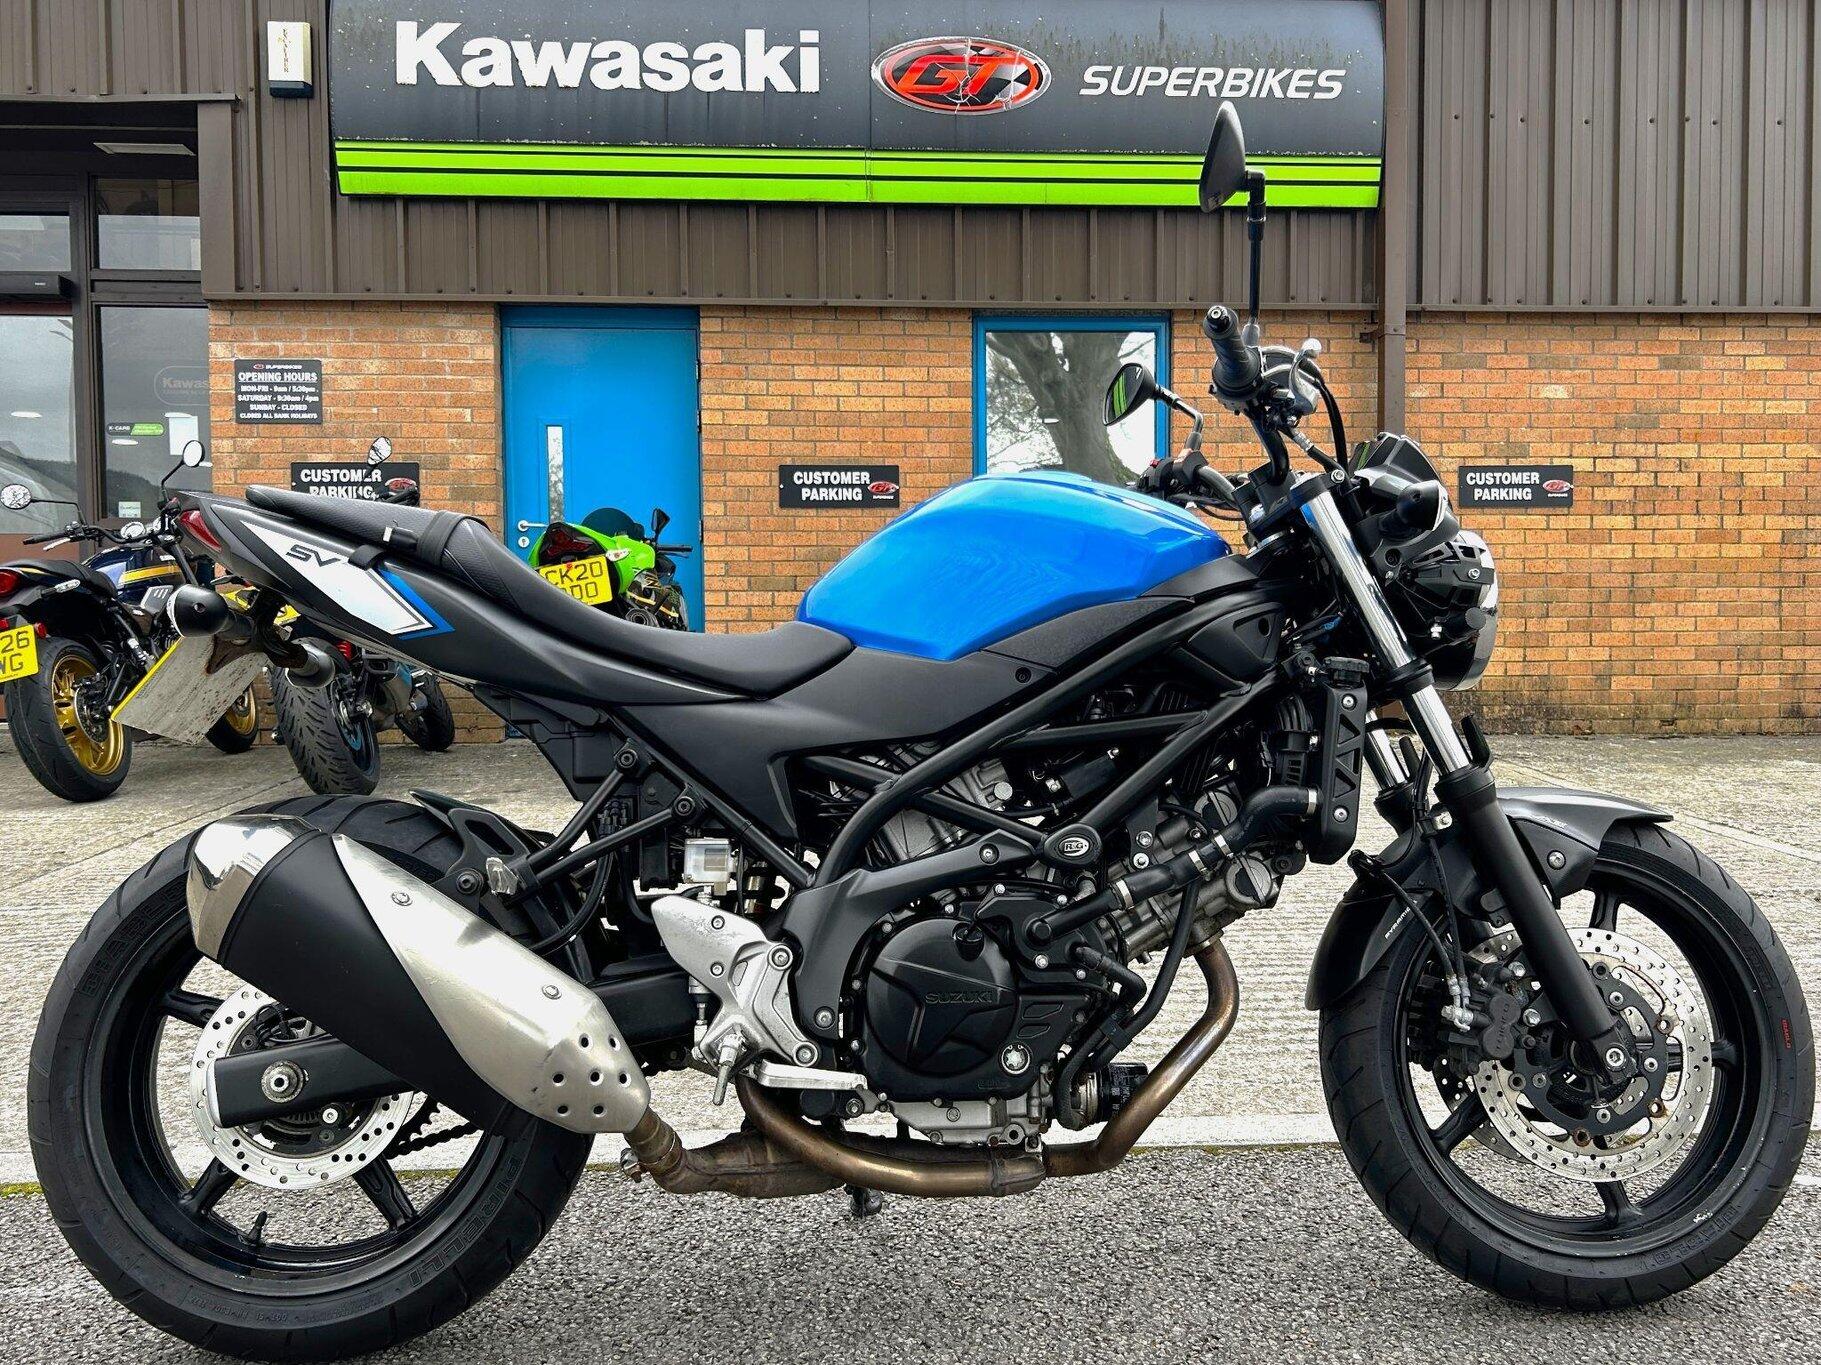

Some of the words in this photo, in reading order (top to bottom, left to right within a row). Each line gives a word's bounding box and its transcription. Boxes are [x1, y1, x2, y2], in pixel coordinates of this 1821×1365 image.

[396, 20, 821, 93] Kawasaki
[897, 54, 1023, 95] GT
[1078, 65, 1347, 100] SUPERBIKES
[238, 372, 282, 381] OPENING
[283, 372, 318, 381] HOURS
[237, 394, 272, 402] SATURDAY
[793, 471, 871, 485] CUSTOMER
[1466, 472, 1540, 485] CUSTOMER
[801, 487, 863, 501] PARKING
[1474, 487, 1533, 501] PARKING
[285, 544, 341, 567] SV
[924, 991, 992, 1005] SUZUKI
[408, 1155, 524, 1290] PIRELLI
